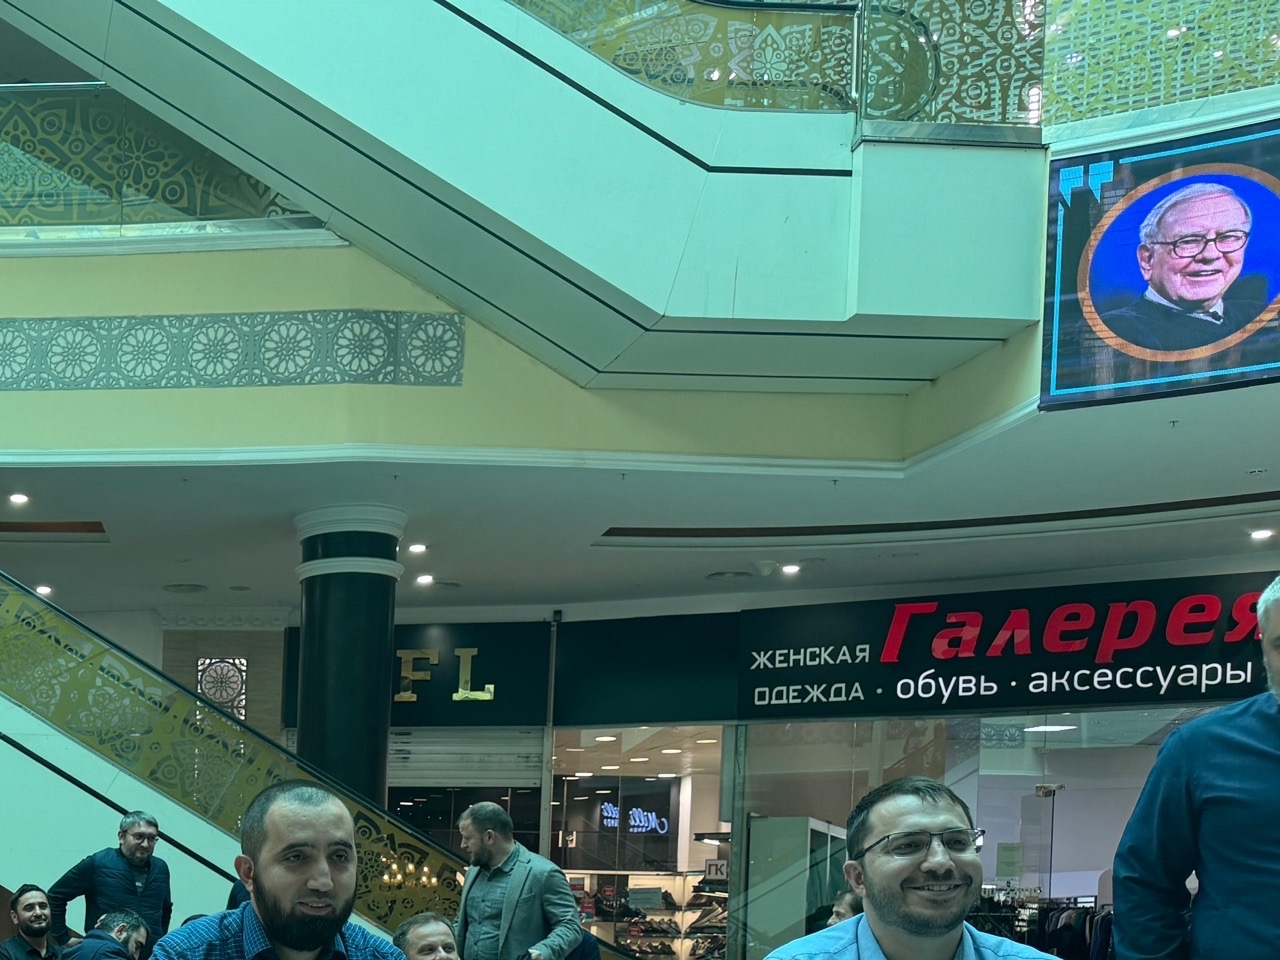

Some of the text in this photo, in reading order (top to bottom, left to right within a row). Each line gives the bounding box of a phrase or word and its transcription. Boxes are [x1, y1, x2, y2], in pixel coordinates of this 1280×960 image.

[879, 590, 1261, 664] Галерея
[393, 647, 495, 702] FL
[749, 643, 870, 670] ЖЕНСКАЯ
[753, 660, 1253, 706] ОДЕЖДА обувь аксессуары
